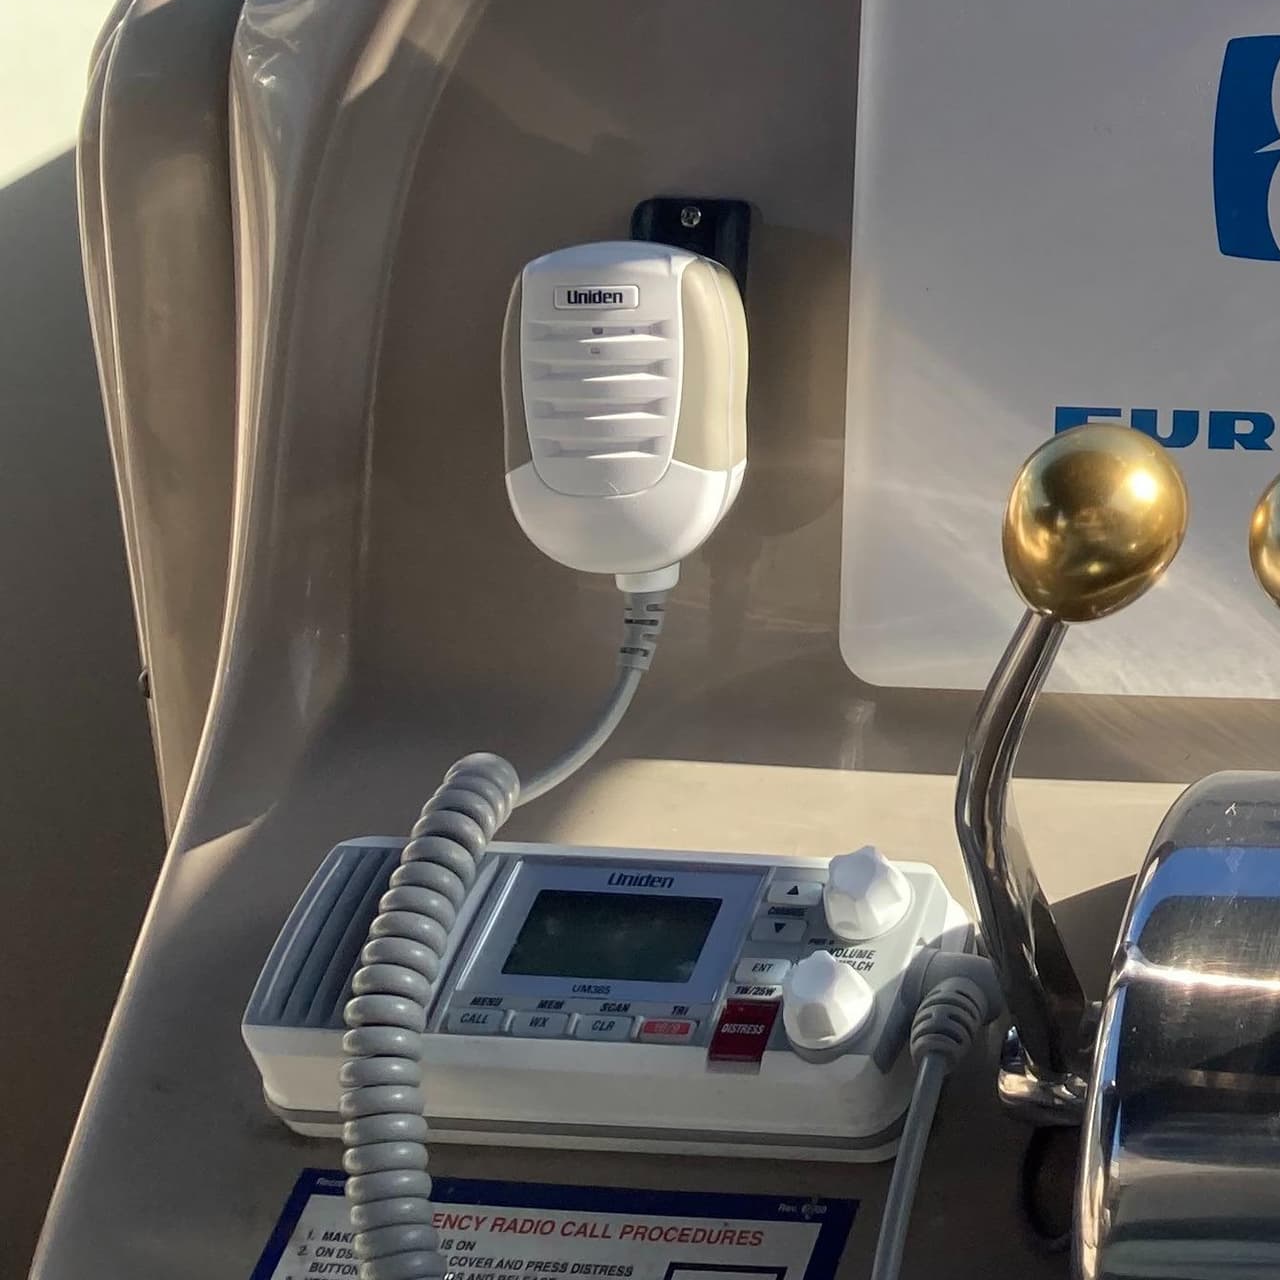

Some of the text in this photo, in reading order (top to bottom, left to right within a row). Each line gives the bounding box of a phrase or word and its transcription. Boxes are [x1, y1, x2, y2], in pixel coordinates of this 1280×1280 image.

[567, 290, 623, 304] Uniden
[607, 872, 674, 888] Uniden
[829, 947, 876, 960] VOLUME
[751, 962, 774, 972] ENT
[734, 985, 777, 997] 1W/25W
[600, 1002, 631, 1013] SCAN
[672, 1005, 690, 1016] TRI
[460, 1013, 489, 1024] CALL
[529, 1016, 549, 1027] WX
[592, 1020, 614, 1031] CLR
[721, 1023, 765, 1035] DISTRESS
[432, 1212, 765, 1247] ENCY RADIO CALL PROCEDURES
[322, 1231, 354, 1244] MAK
[440, 1238, 453, 1251] IS
[456, 1239, 477, 1252] ON
[309, 1262, 358, 1275] BUTTON
[315, 1246, 333, 1258] ON
[336, 1247, 354, 1260] DS
[449, 1255, 493, 1269] COVER
[496, 1258, 524, 1272] AND
[525, 1260, 568, 1274] PRESS
[572, 1263, 633, 1277] DISTRESS
